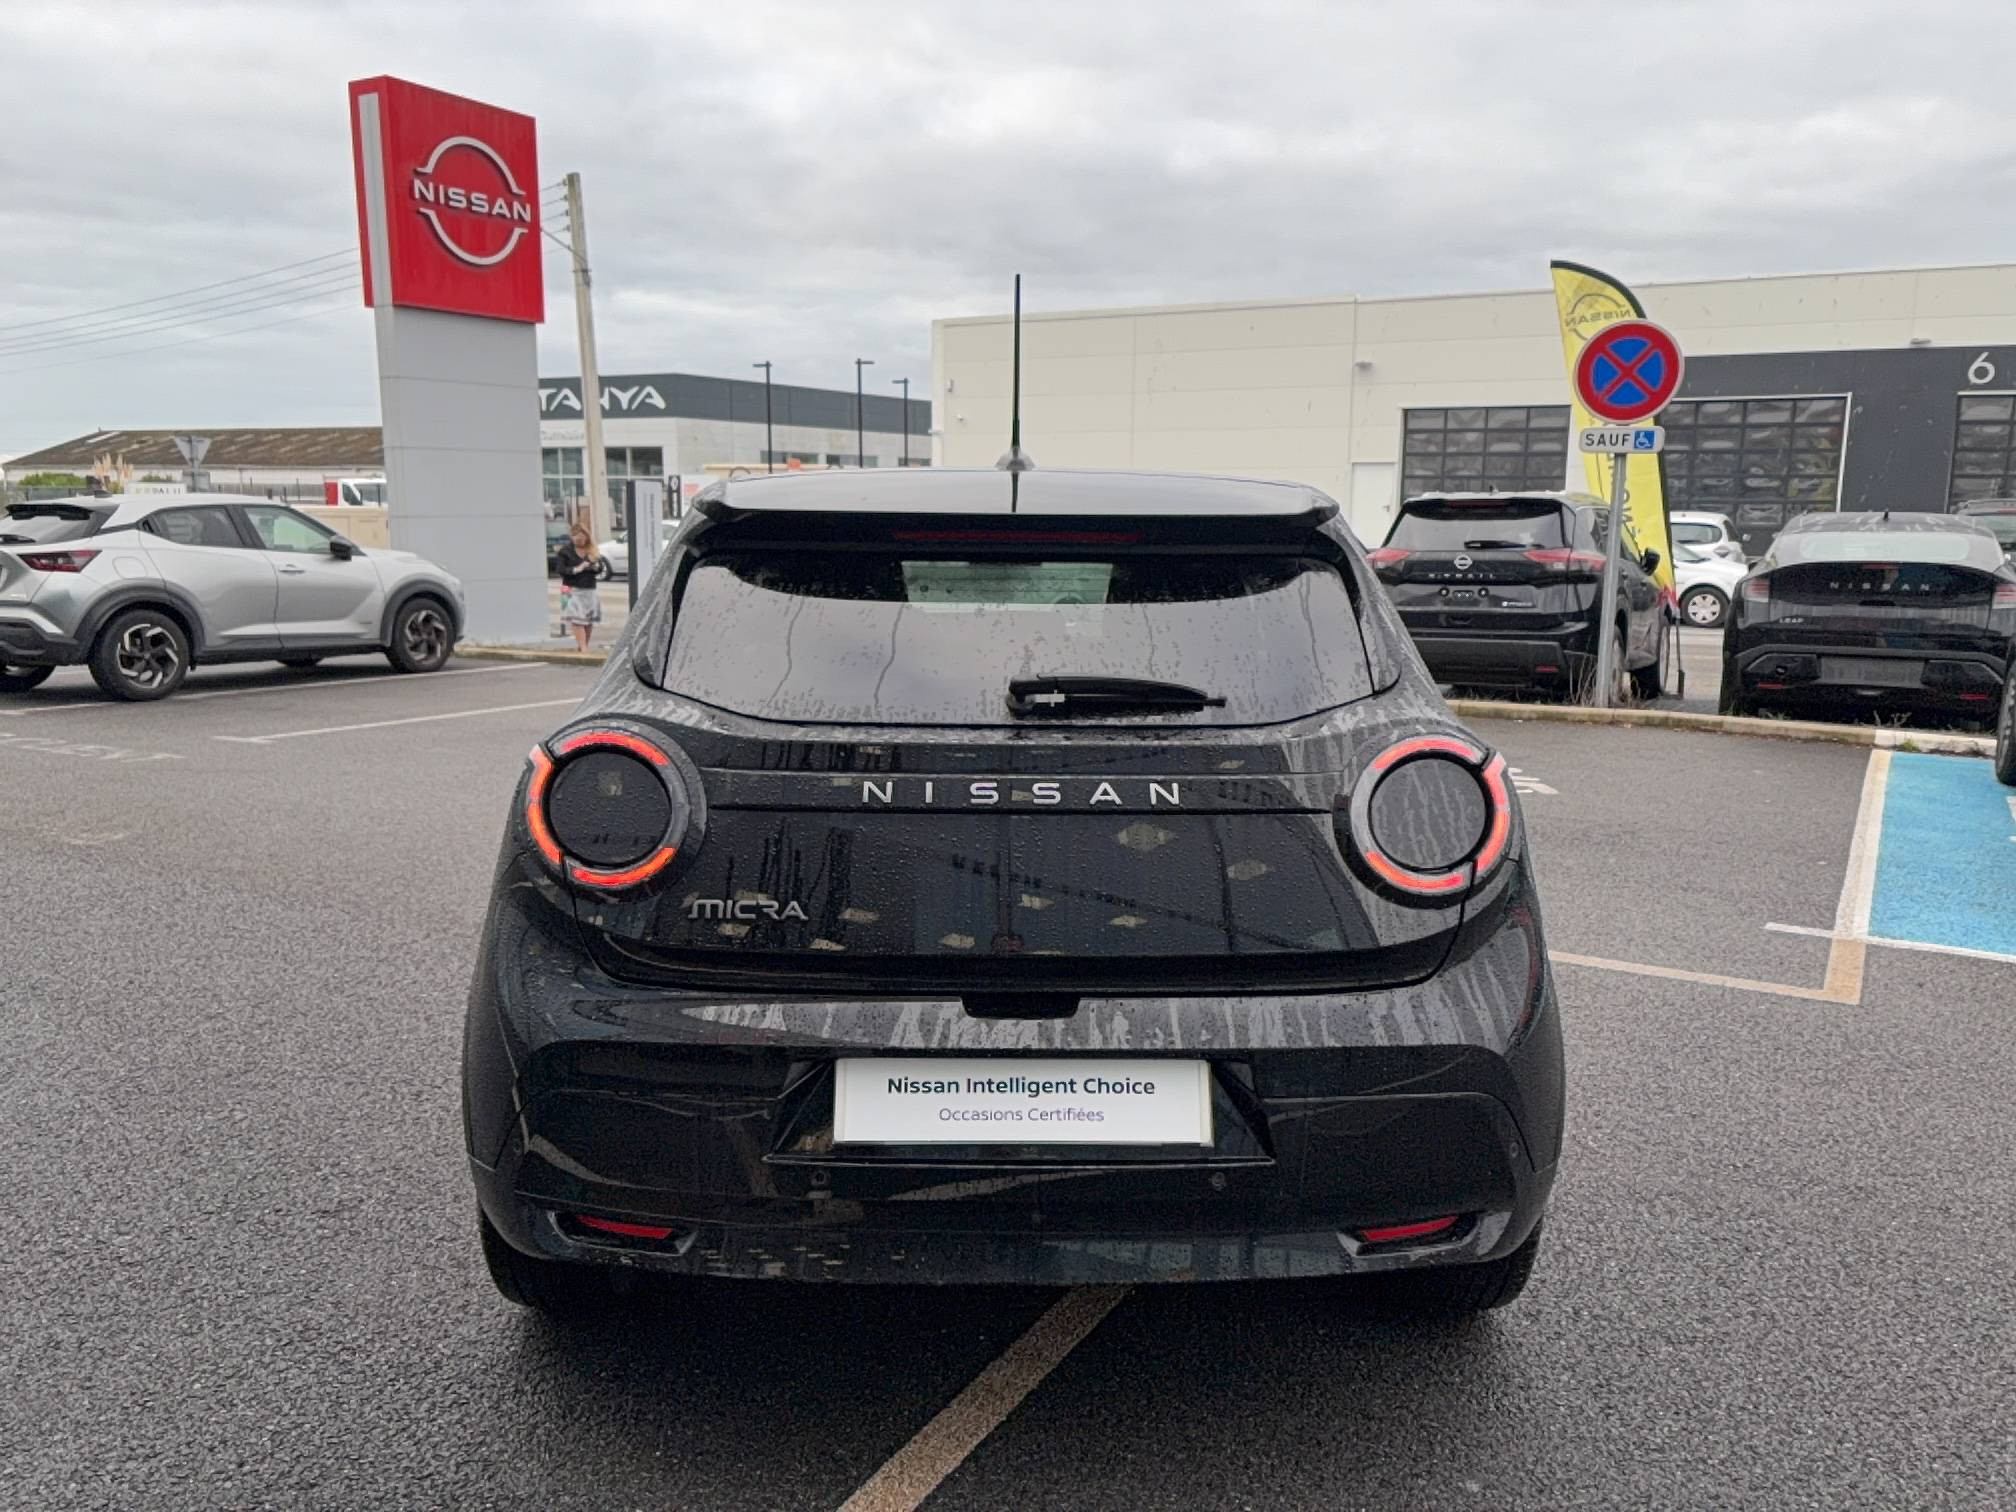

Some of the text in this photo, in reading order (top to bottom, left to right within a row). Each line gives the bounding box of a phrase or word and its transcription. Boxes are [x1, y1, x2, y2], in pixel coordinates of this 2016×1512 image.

[413, 178, 532, 223] NISSAN
[1968, 351, 1995, 385] 6
[1585, 433, 1631, 447] SAUF
[1830, 582, 1931, 591] NISSAN
[861, 781, 1181, 805] NISSAN
[687, 898, 809, 921] MICRA
[887, 1077, 1155, 1098] Nissan Intelligent Choice
[938, 1107, 1105, 1122] Occasions Certifiées
